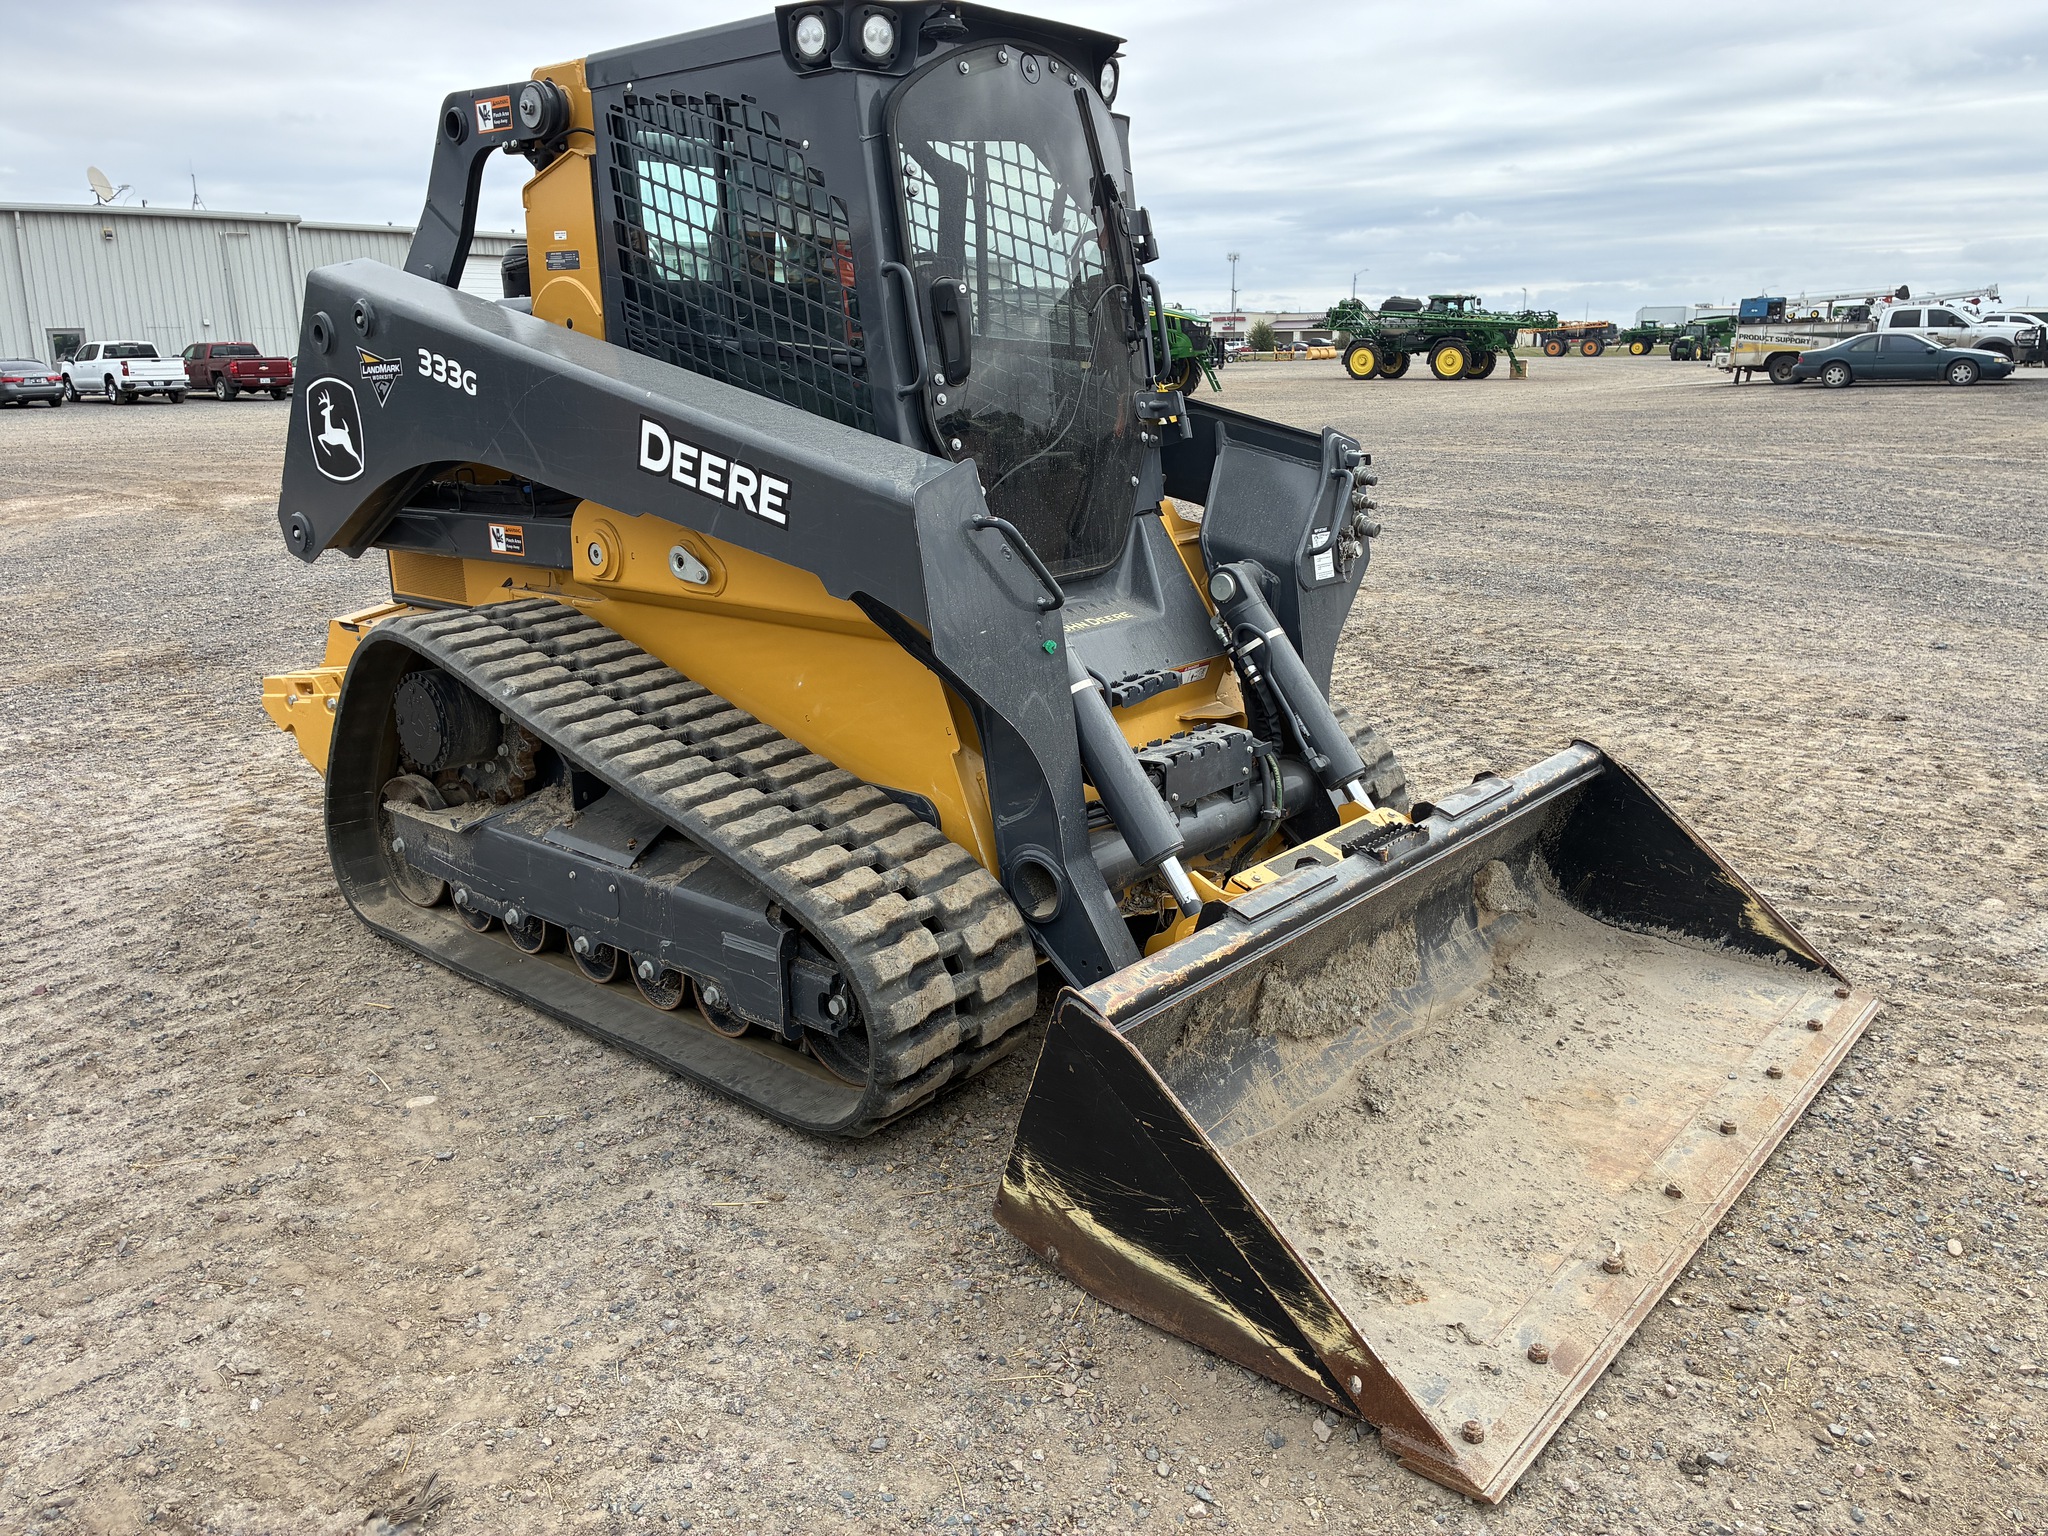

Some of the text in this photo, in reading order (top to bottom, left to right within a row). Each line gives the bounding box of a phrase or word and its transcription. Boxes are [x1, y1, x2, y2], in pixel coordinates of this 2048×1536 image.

[1739, 334, 1811, 345] PRODUCT SUPPORT
[418, 348, 477, 396] 333G
[640, 419, 789, 525] DEERE
[1063, 611, 1134, 632] OHN DEERE
